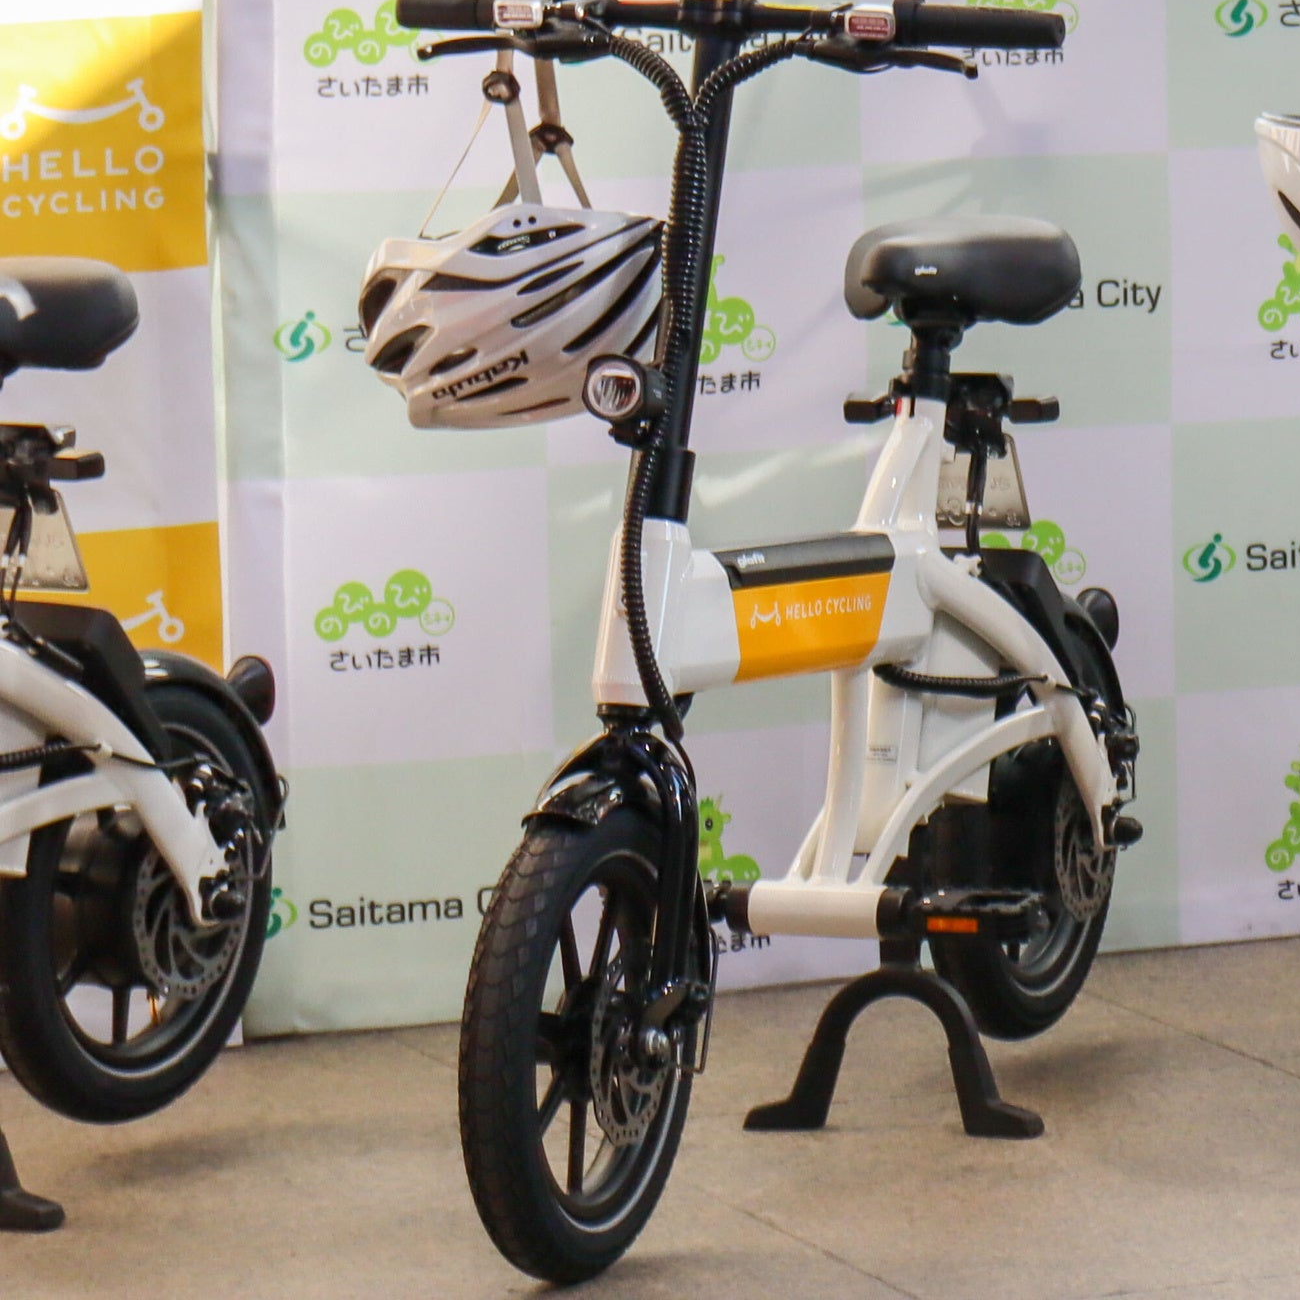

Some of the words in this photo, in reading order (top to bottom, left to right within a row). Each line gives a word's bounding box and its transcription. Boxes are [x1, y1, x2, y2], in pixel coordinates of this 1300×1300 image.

[316, 75, 430, 98] さいたま市
[2, 145, 165, 182] HELLO
[2, 186, 165, 218] CYCLING
[1097, 279, 1161, 313] City
[431, 348, 529, 400] Kabuto
[318, 581, 428, 634] のびのび
[786, 599, 822, 620] HELLO
[825, 595, 872, 615] CYCLING
[329, 645, 440, 672] さいたま市
[309, 897, 463, 929] Saitama
